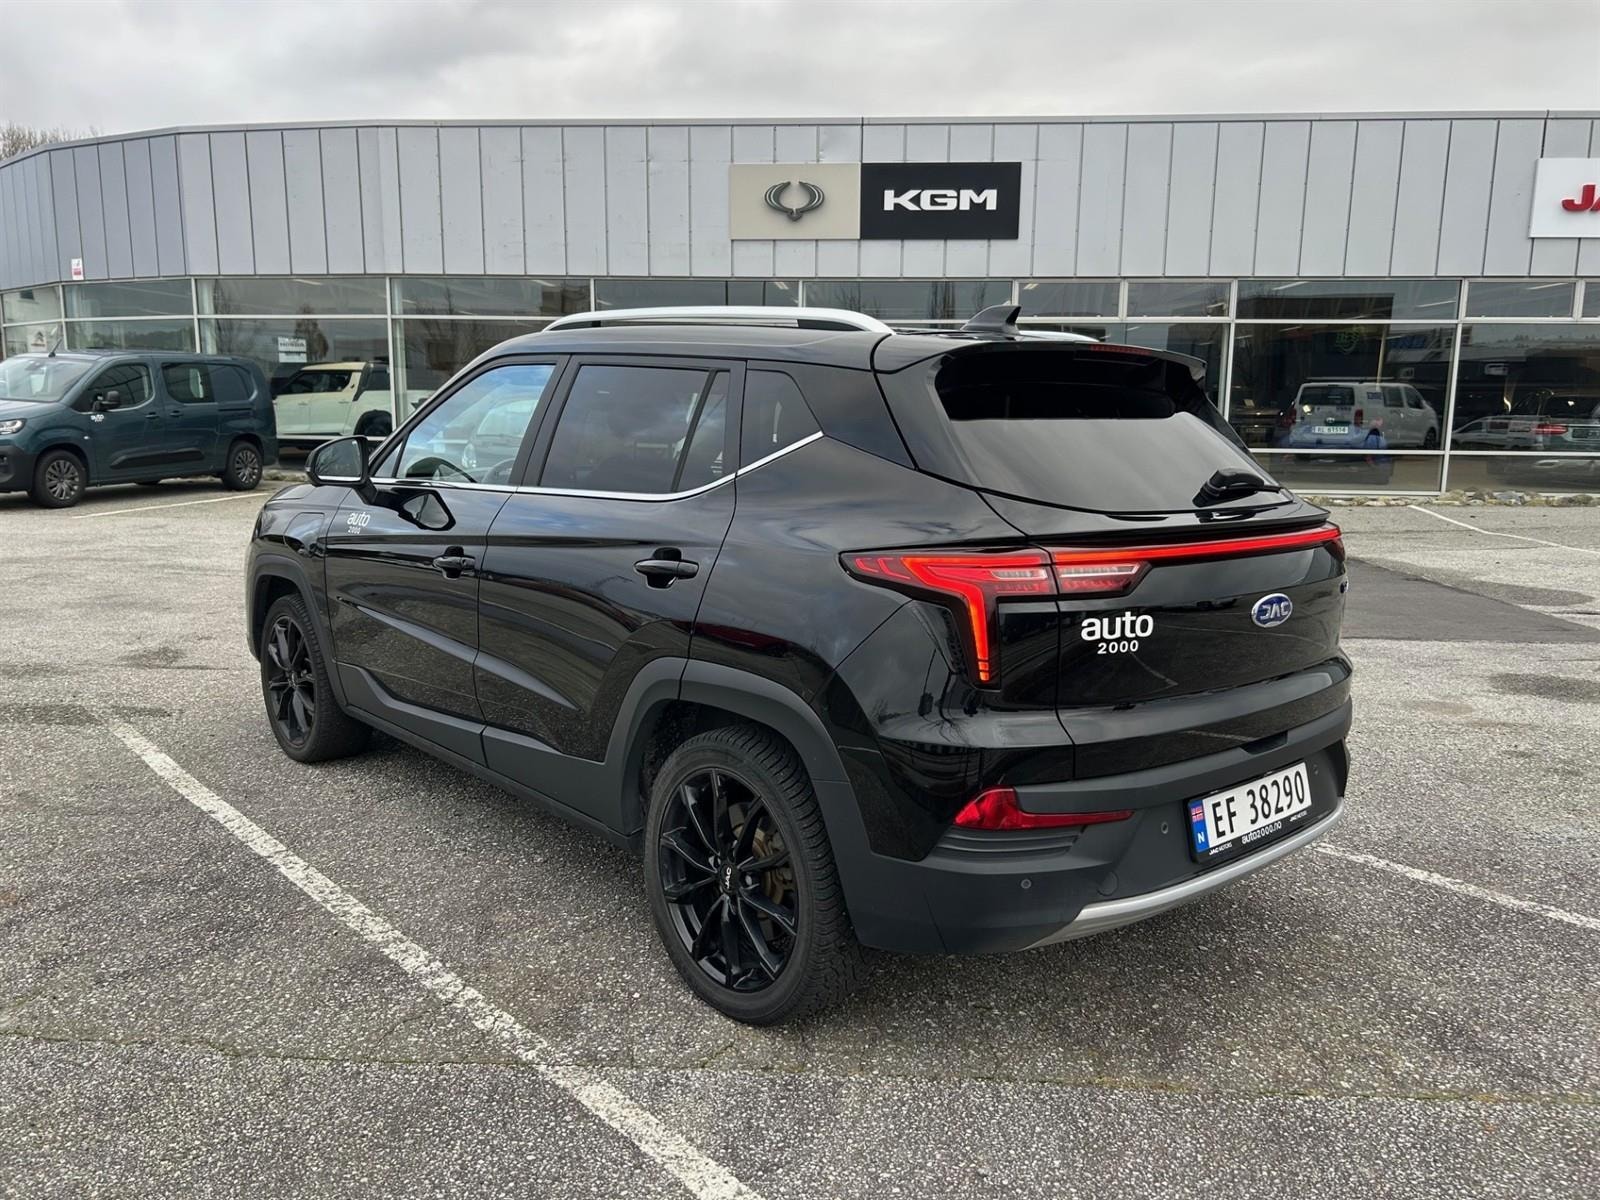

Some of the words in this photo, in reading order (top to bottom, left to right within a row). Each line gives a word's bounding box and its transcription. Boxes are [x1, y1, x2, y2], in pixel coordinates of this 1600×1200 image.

[883, 189, 997, 211] KGM
[1561, 184, 1600, 212] J
[346, 511, 371, 527] auto
[1080, 611, 1154, 641] auto
[1097, 639, 1139, 655] 2000
[1211, 796, 1237, 839] EF
[1246, 770, 1305, 825] 38290
[1197, 831, 1205, 844] N
[1241, 821, 1282, 844] auto2000.no
